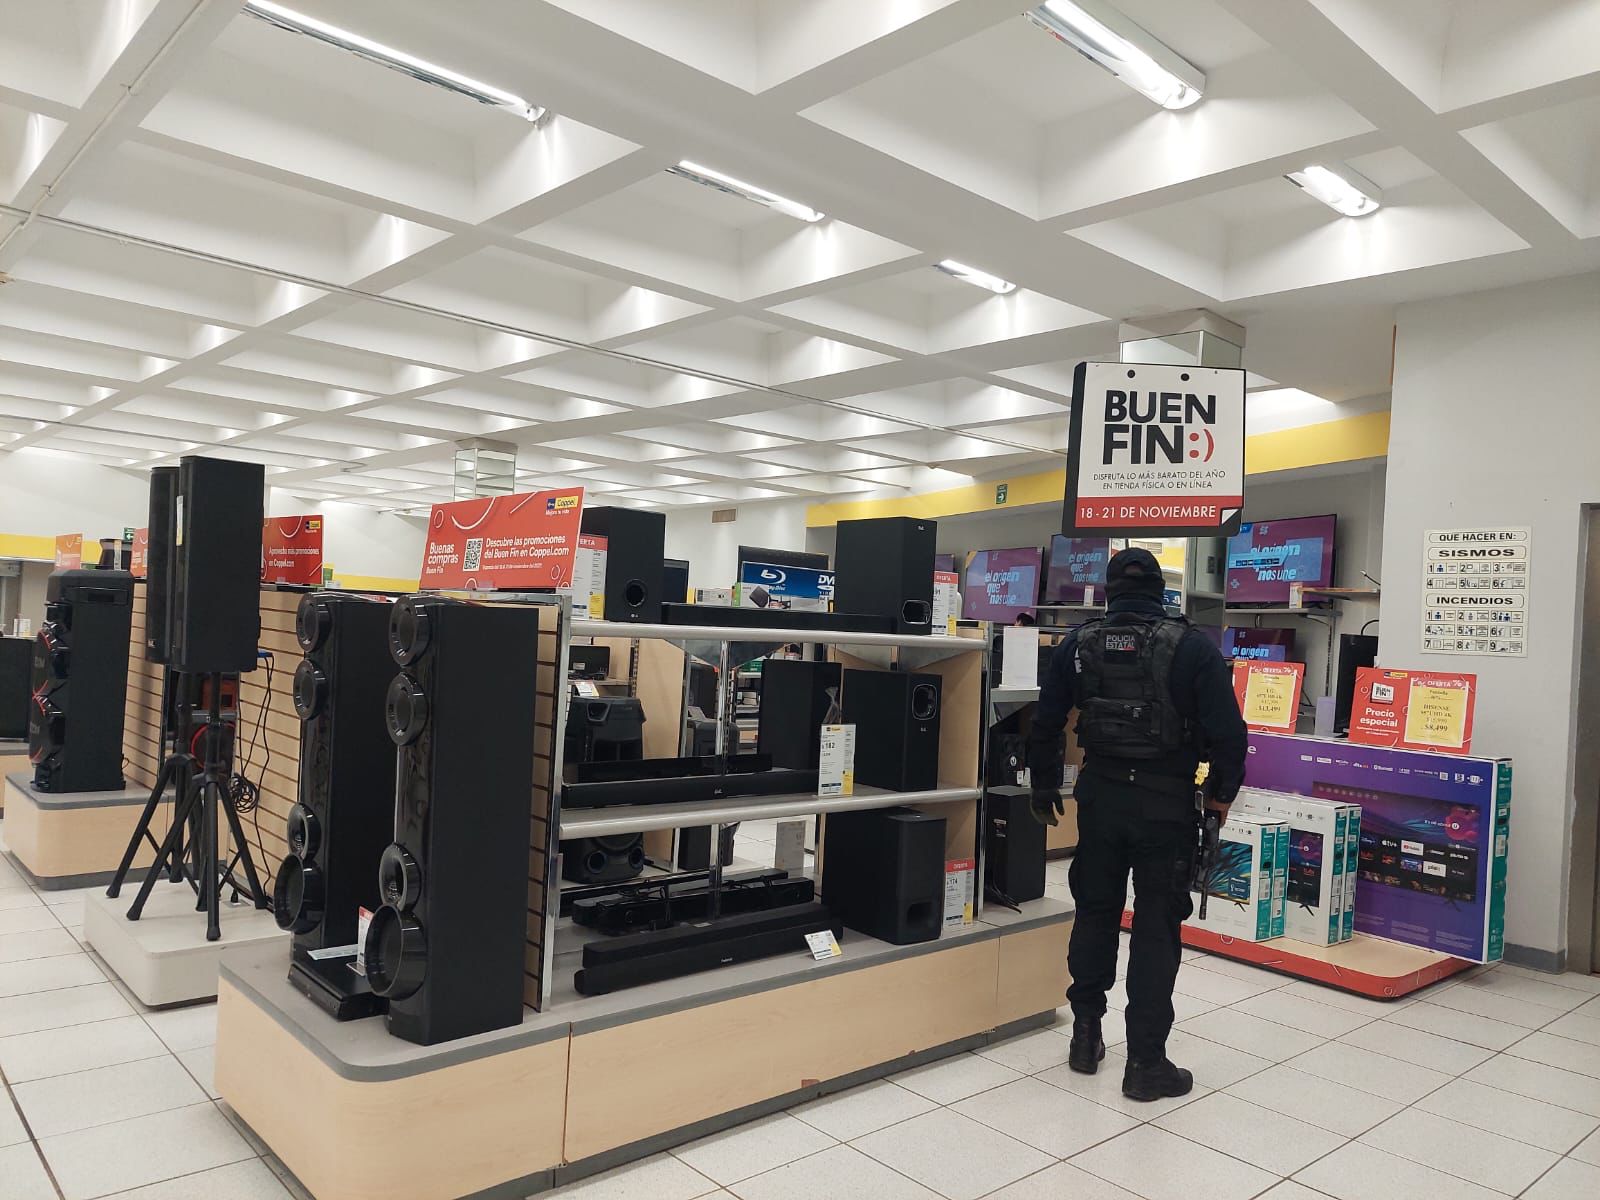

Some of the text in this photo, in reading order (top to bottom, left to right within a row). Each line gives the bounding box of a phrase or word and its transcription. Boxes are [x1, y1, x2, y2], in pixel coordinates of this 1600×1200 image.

[1104, 389, 1216, 425] BUEN
[1093, 469, 1226, 481] DISFRUTA LO MÁS BARATO DEL AÑO
[1102, 479, 1213, 490] EN TIENDA FÍSICA O EN LÍNEA
[1080, 507, 1093, 519] 18
[1102, 506, 1115, 519] 21
[1120, 506, 1135, 519] DE
[1139, 505, 1217, 518] NOVIEMBRE
[486, 533, 566, 547] Descubre las promociones
[1439, 532, 1517, 542] QUE HACER EN:
[429, 542, 455, 554] Buenas
[484, 546, 570, 559] del Buen Fin en Coppel.com
[1438, 548, 1515, 557] SISMOS
[428, 554, 459, 567] compras
[1460, 564, 1466, 572] 2
[1494, 563, 1500, 572] 3
[818, 574, 835, 585] DV
[993, 569, 1020, 586] origen
[1427, 578, 1499, 588] 4 5 6
[1436, 596, 1514, 605] INCENDIOS
[1458, 612, 1464, 620] 2
[1491, 612, 1497, 620] 3
[1457, 626, 1463, 634] 5
[1491, 627, 1497, 635] 6
[1106, 634, 1135, 642] POLICIA
[1105, 642, 1135, 650] ESTATAL
[1425, 640, 1496, 650] 7 8 9
[1241, 645, 1270, 659] origen
[1365, 707, 1395, 718] Precio
[1360, 717, 1398, 727] especial
